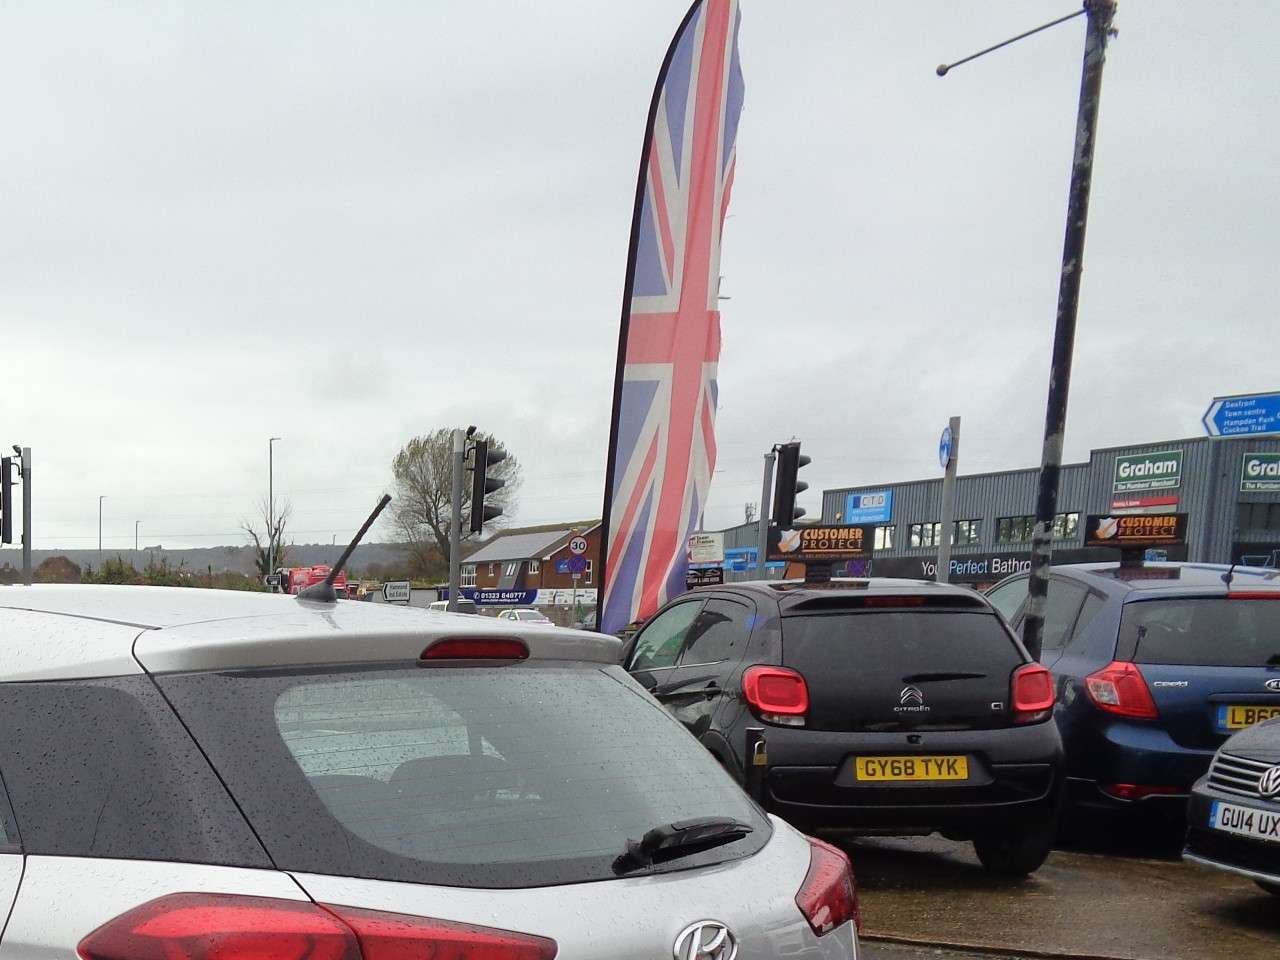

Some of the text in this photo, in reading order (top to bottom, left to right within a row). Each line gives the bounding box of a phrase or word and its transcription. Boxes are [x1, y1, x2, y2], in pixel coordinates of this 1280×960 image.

[1119, 460, 1177, 478] Graham
[1120, 516, 1177, 527] CUSTOMER
[803, 528, 863, 540] CUSTOMER
[1118, 526, 1176, 536] PROTECT
[571, 541, 585, 550] 30
[802, 539, 864, 550] PROTECT
[949, 558, 988, 575] Perfect
[865, 759, 958, 777] GY68 TYK
[1222, 807, 1253, 832] GU14
